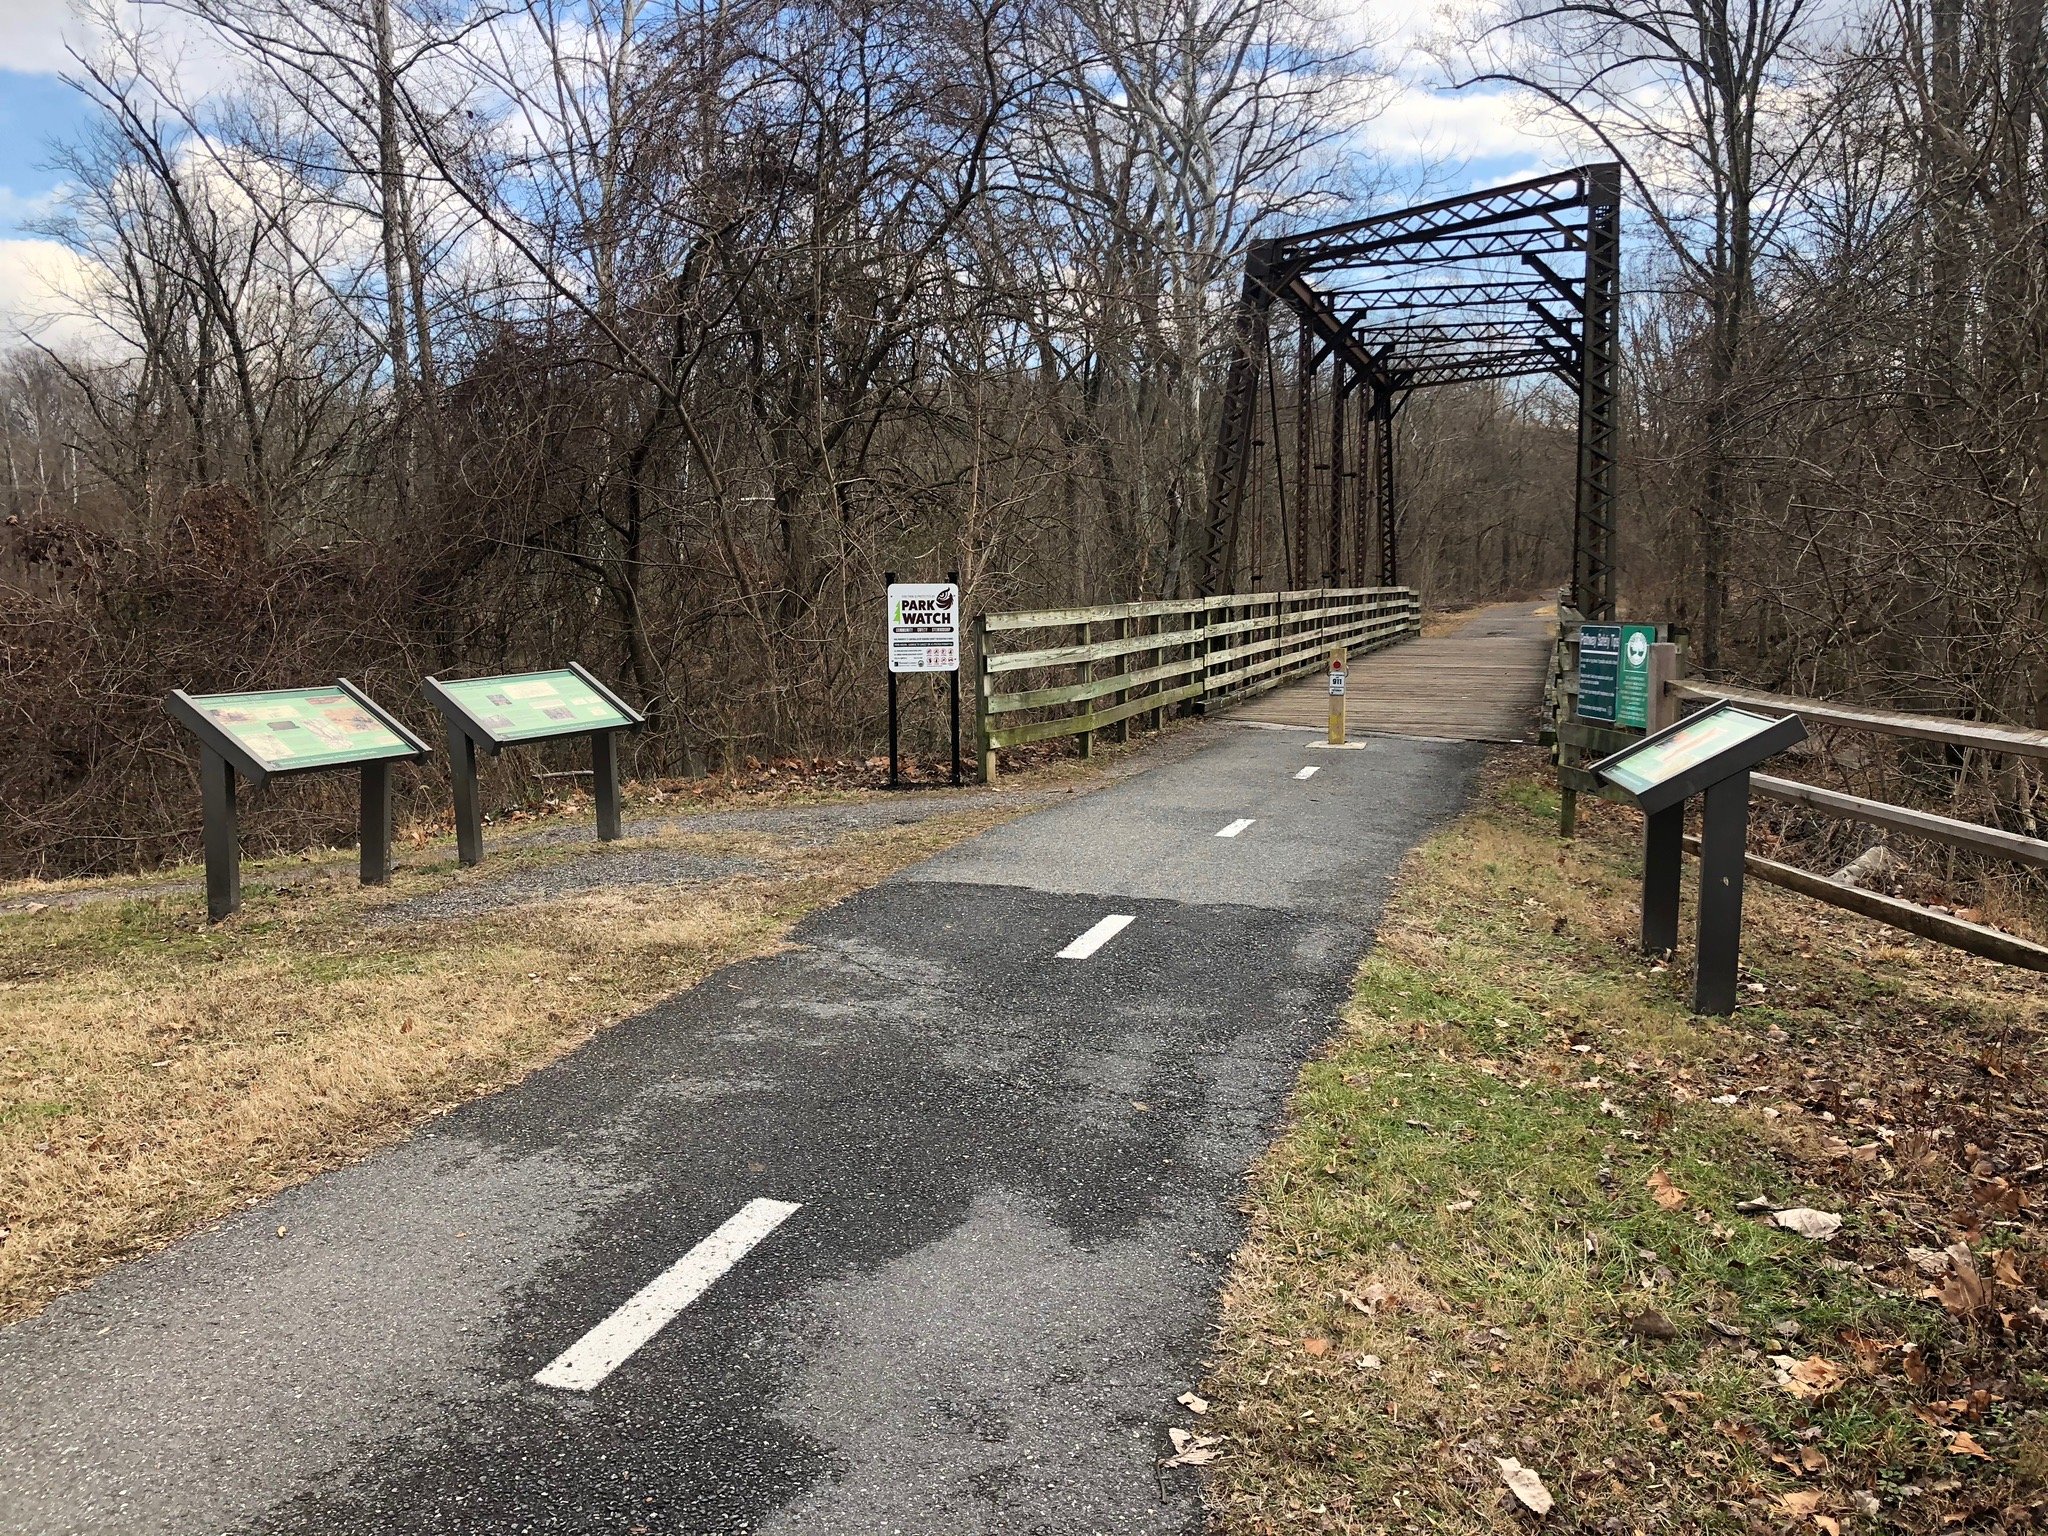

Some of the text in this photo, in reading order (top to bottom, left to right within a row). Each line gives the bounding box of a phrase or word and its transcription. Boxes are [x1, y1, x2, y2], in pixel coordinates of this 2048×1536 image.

[902, 600, 935, 610] PARK
[902, 613, 950, 624] WATCH
[1597, 633, 1610, 649] Safety
